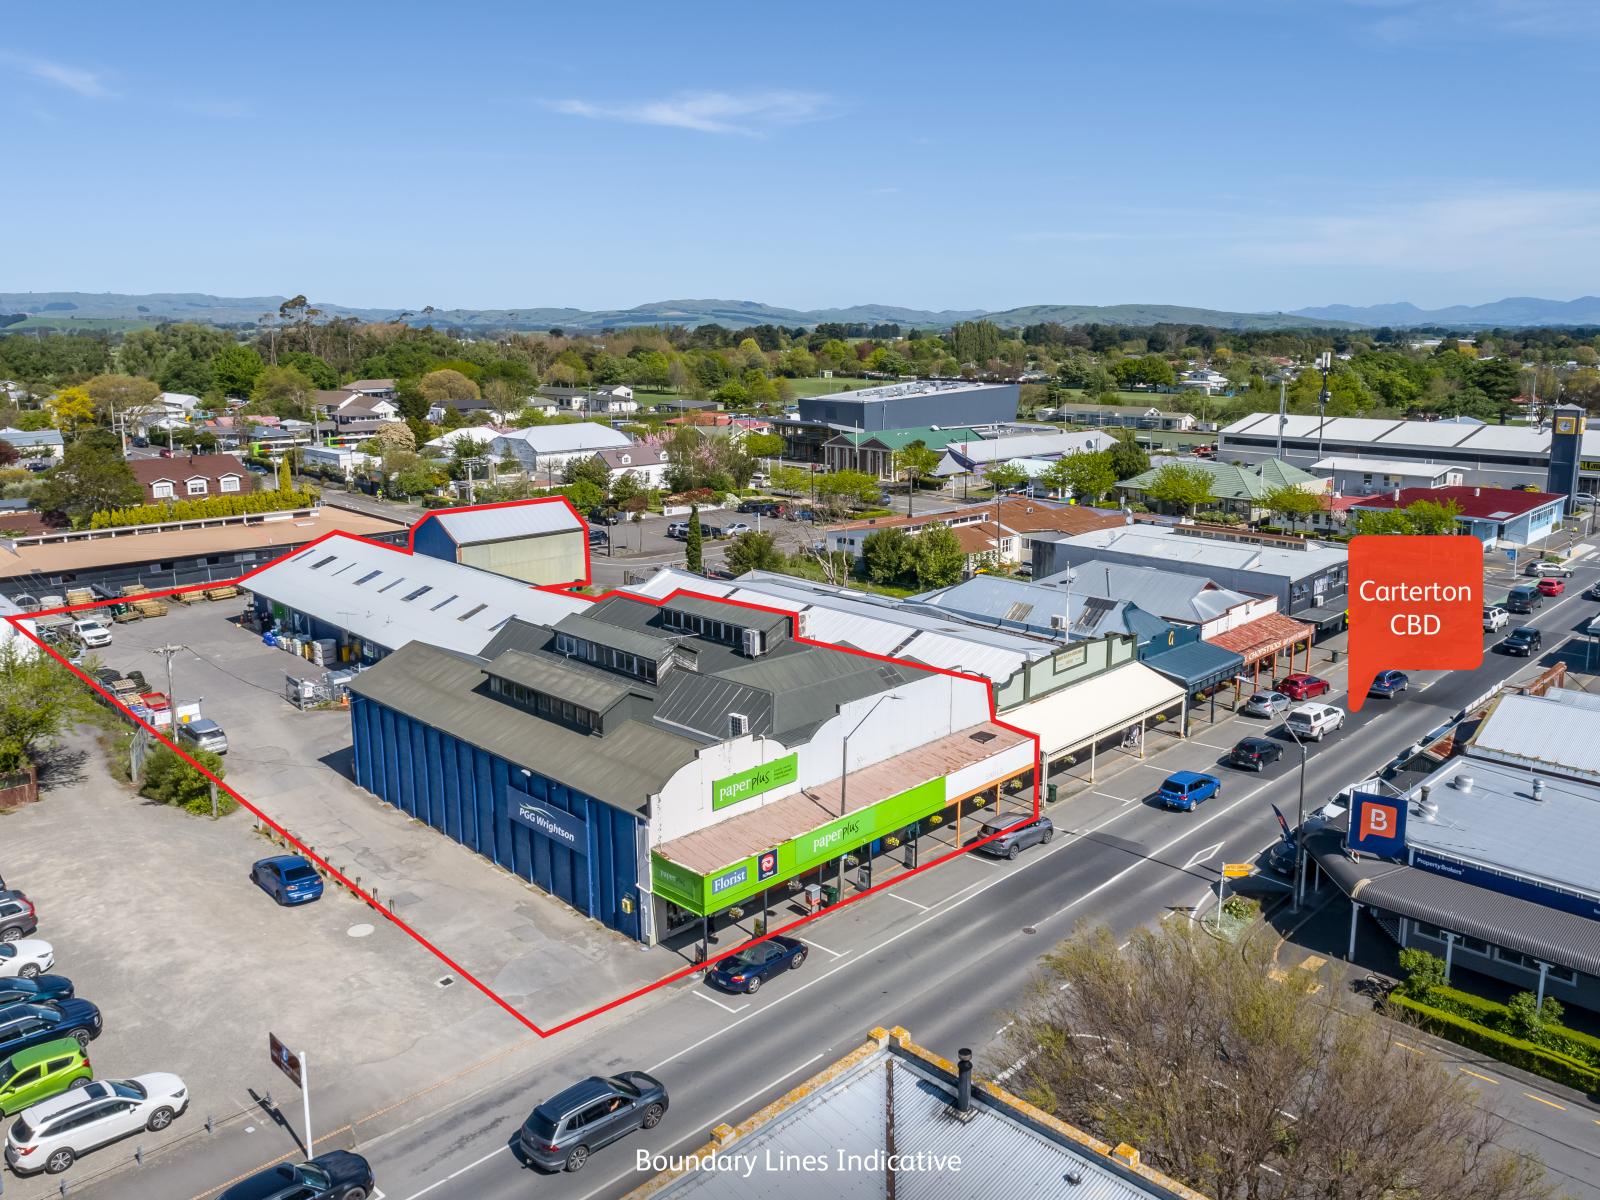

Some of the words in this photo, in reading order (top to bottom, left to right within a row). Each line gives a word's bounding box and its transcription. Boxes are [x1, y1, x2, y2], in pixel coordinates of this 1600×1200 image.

[520, 808, 535, 822] PGG
[536, 815, 575, 842] Wrightson
[1370, 808, 1388, 831] B
[714, 871, 746, 893] Florist
